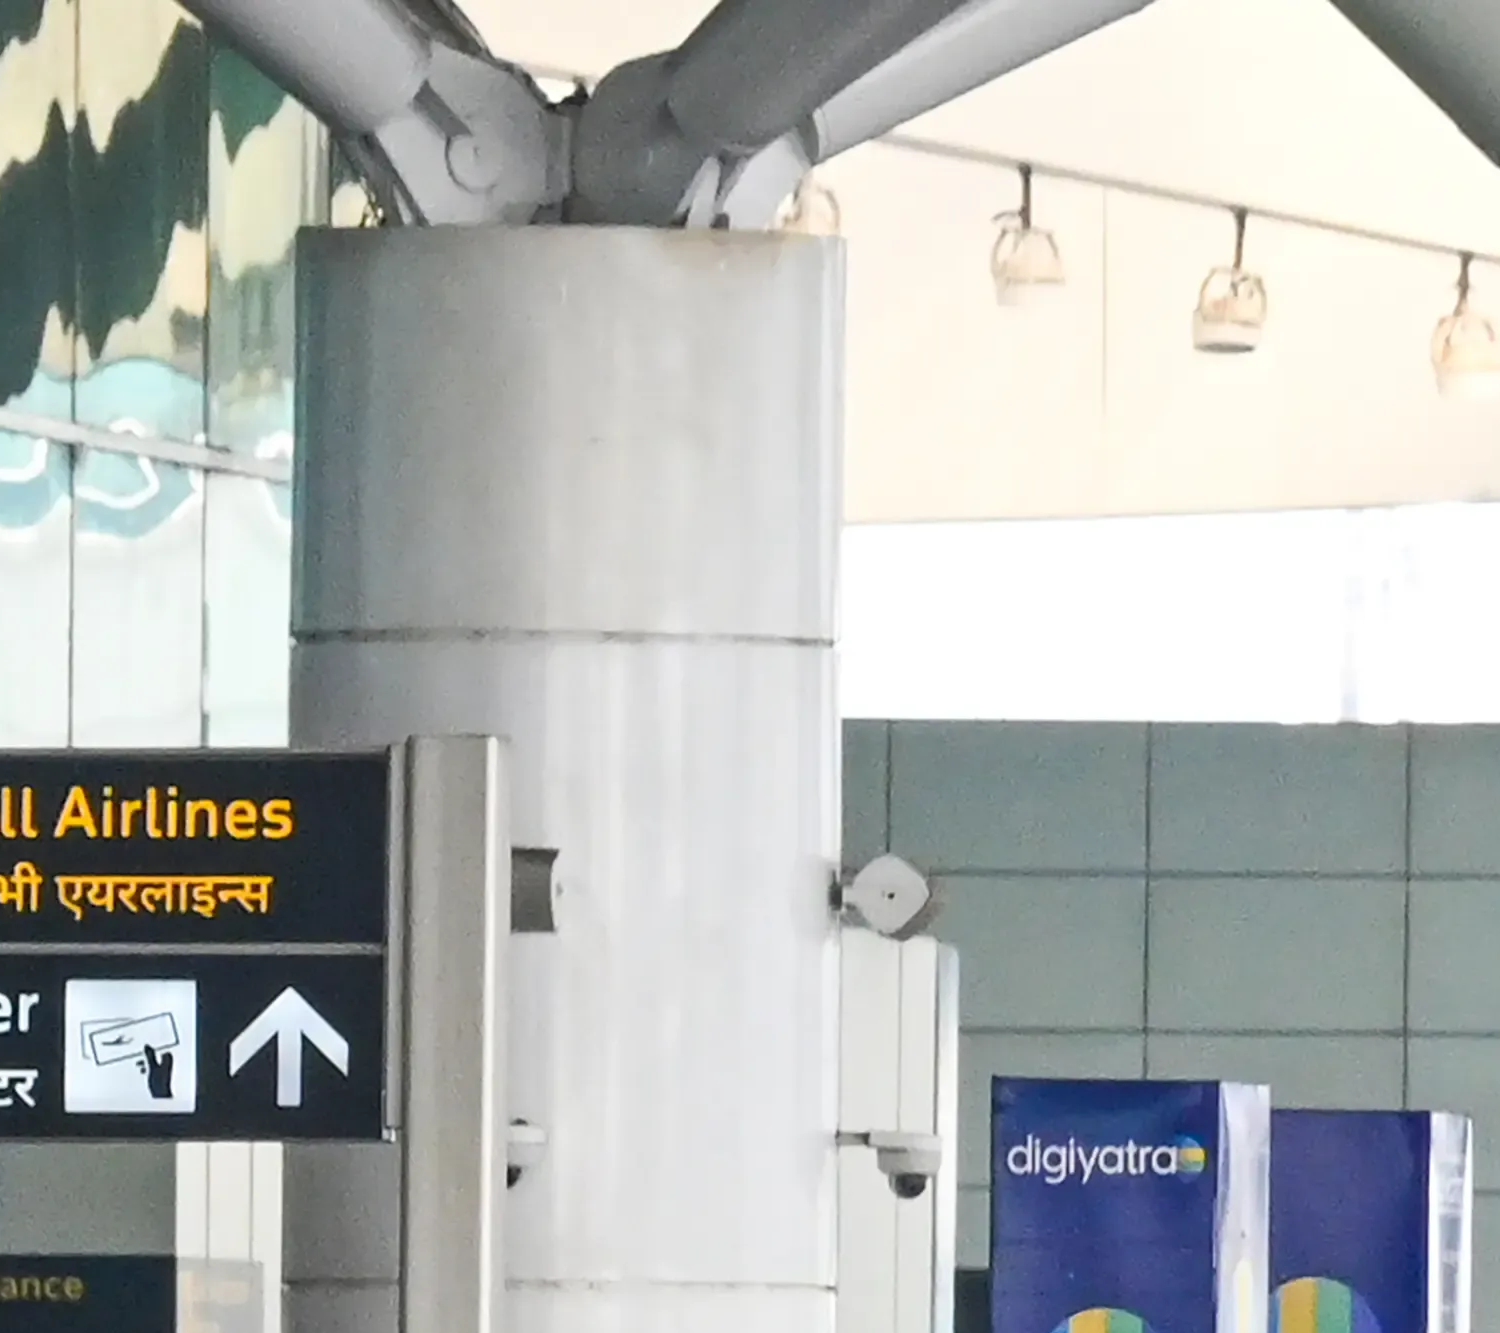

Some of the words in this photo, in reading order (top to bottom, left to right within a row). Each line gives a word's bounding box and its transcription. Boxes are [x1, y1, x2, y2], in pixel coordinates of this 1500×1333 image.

[54, 785, 293, 839] Airlines
[54, 875, 274, 920] एयरलाइन्स
[1007, 1133, 1177, 1184] digiyatra
